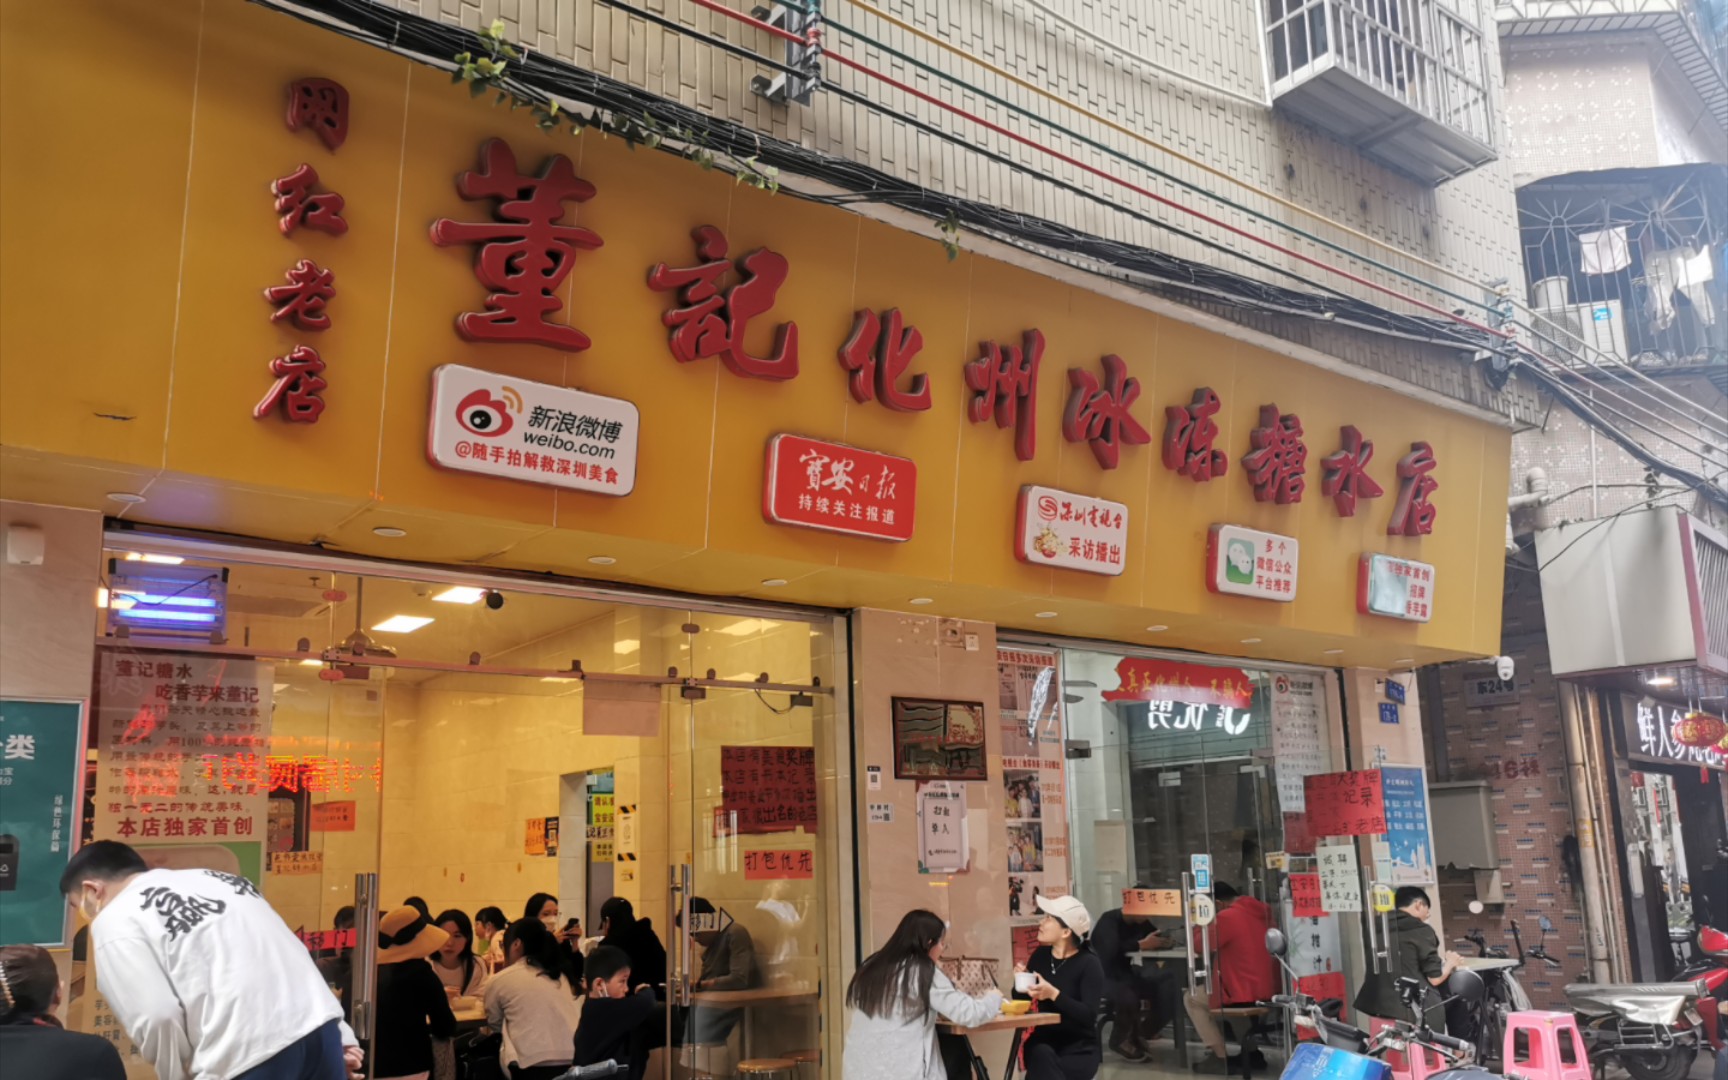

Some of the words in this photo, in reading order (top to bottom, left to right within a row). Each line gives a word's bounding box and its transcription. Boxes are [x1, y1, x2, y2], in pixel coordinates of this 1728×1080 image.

[254, 77, 350, 424] 网红老店
[528, 405, 623, 444] 新浪微博
[524, 431, 615, 460] weibo.com
[455, 441, 619, 485] @随手拍解救深圳美食
[798, 493, 895, 525] 持续关注报道
[1069, 537, 1120, 564] 采访播出
[1265, 538, 1286, 555] 多个
[1256, 574, 1291, 593] 平台推荐
[116, 659, 192, 679] 董记糖水
[155, 683, 260, 703] 吃香芋来董记
[0, 735, 35, 760] 类
[118, 816, 253, 838] 本店独家首创
[744, 852, 813, 871] 打包优先
